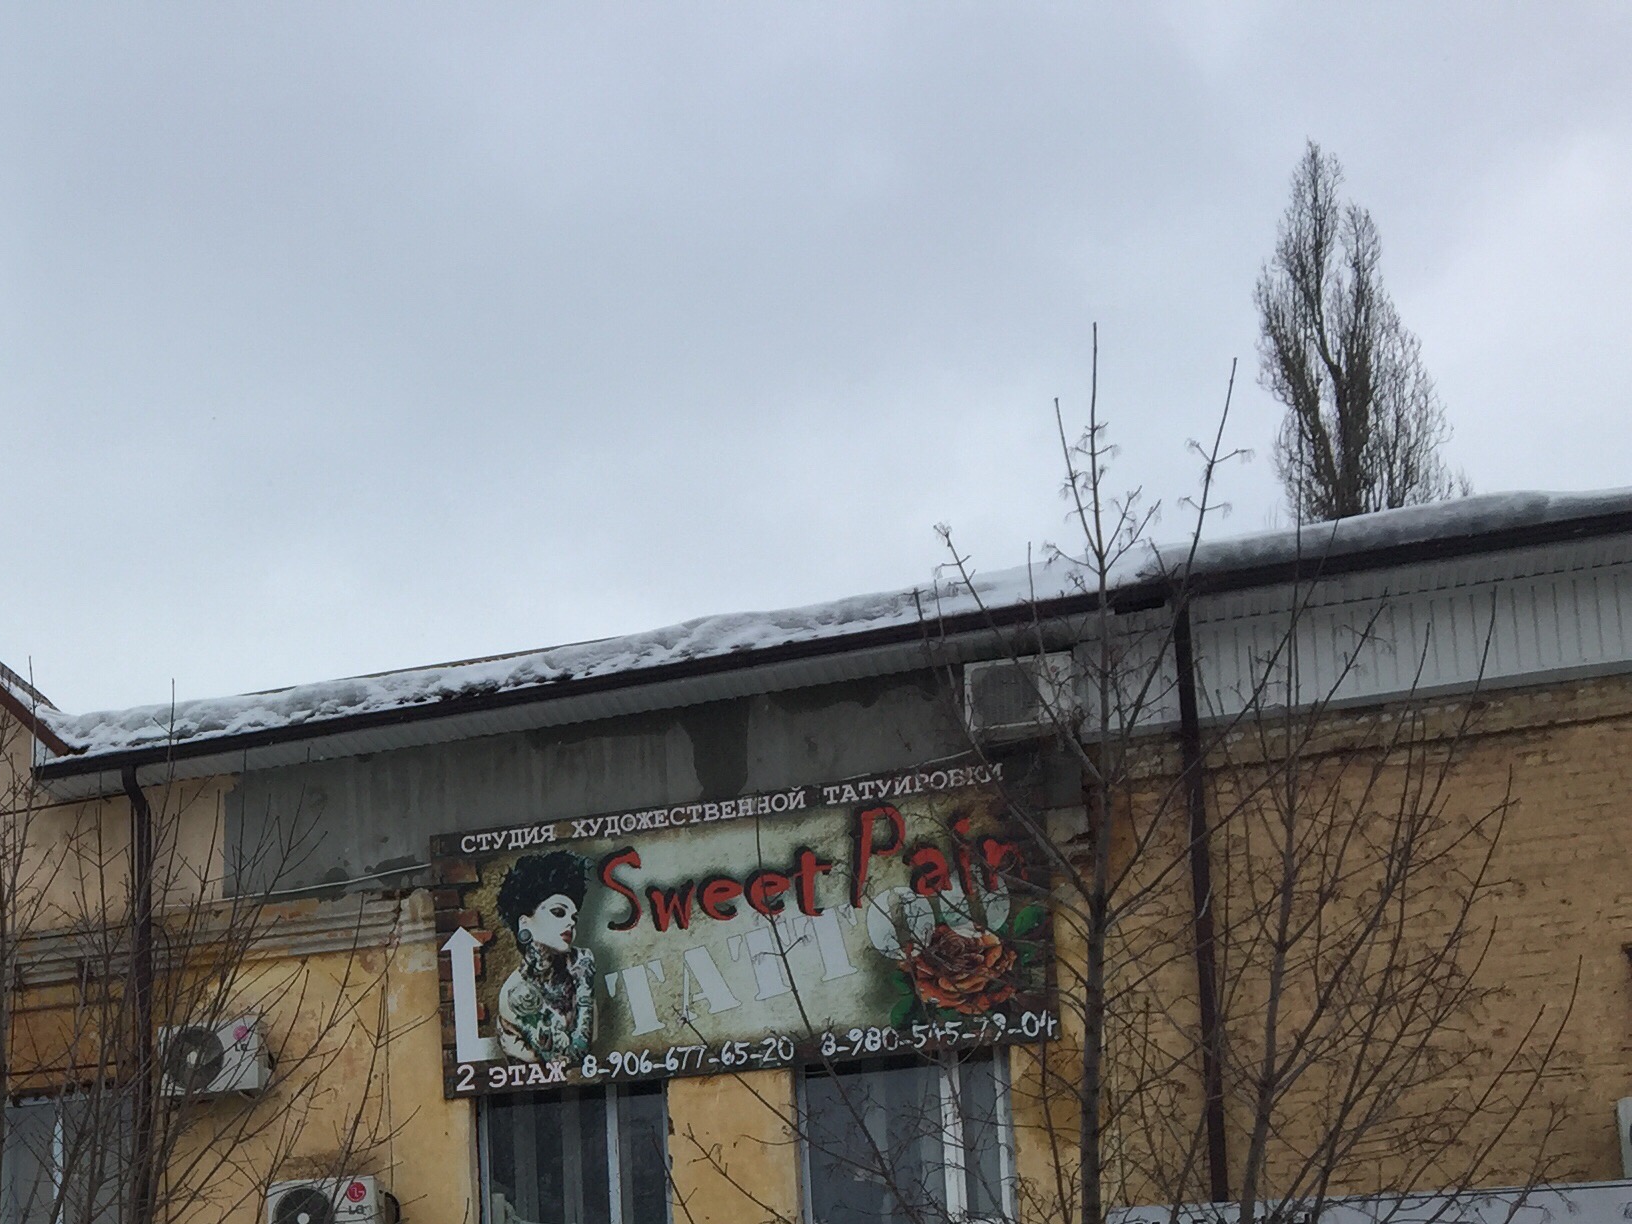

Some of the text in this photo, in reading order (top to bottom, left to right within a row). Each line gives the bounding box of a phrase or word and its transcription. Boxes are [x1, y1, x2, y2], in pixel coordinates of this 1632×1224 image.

[461, 762, 1004, 853] СТУДИЯ ХУДОЖЕСТВЕННОЙ ТАТУИРОВКИ
[596, 845, 832, 932] Sweet
[456, 1064, 476, 1091] 2
[487, 1060, 568, 1089] ЭТАЖ
[580, 1034, 795, 1079] 8-906-677-65-20
